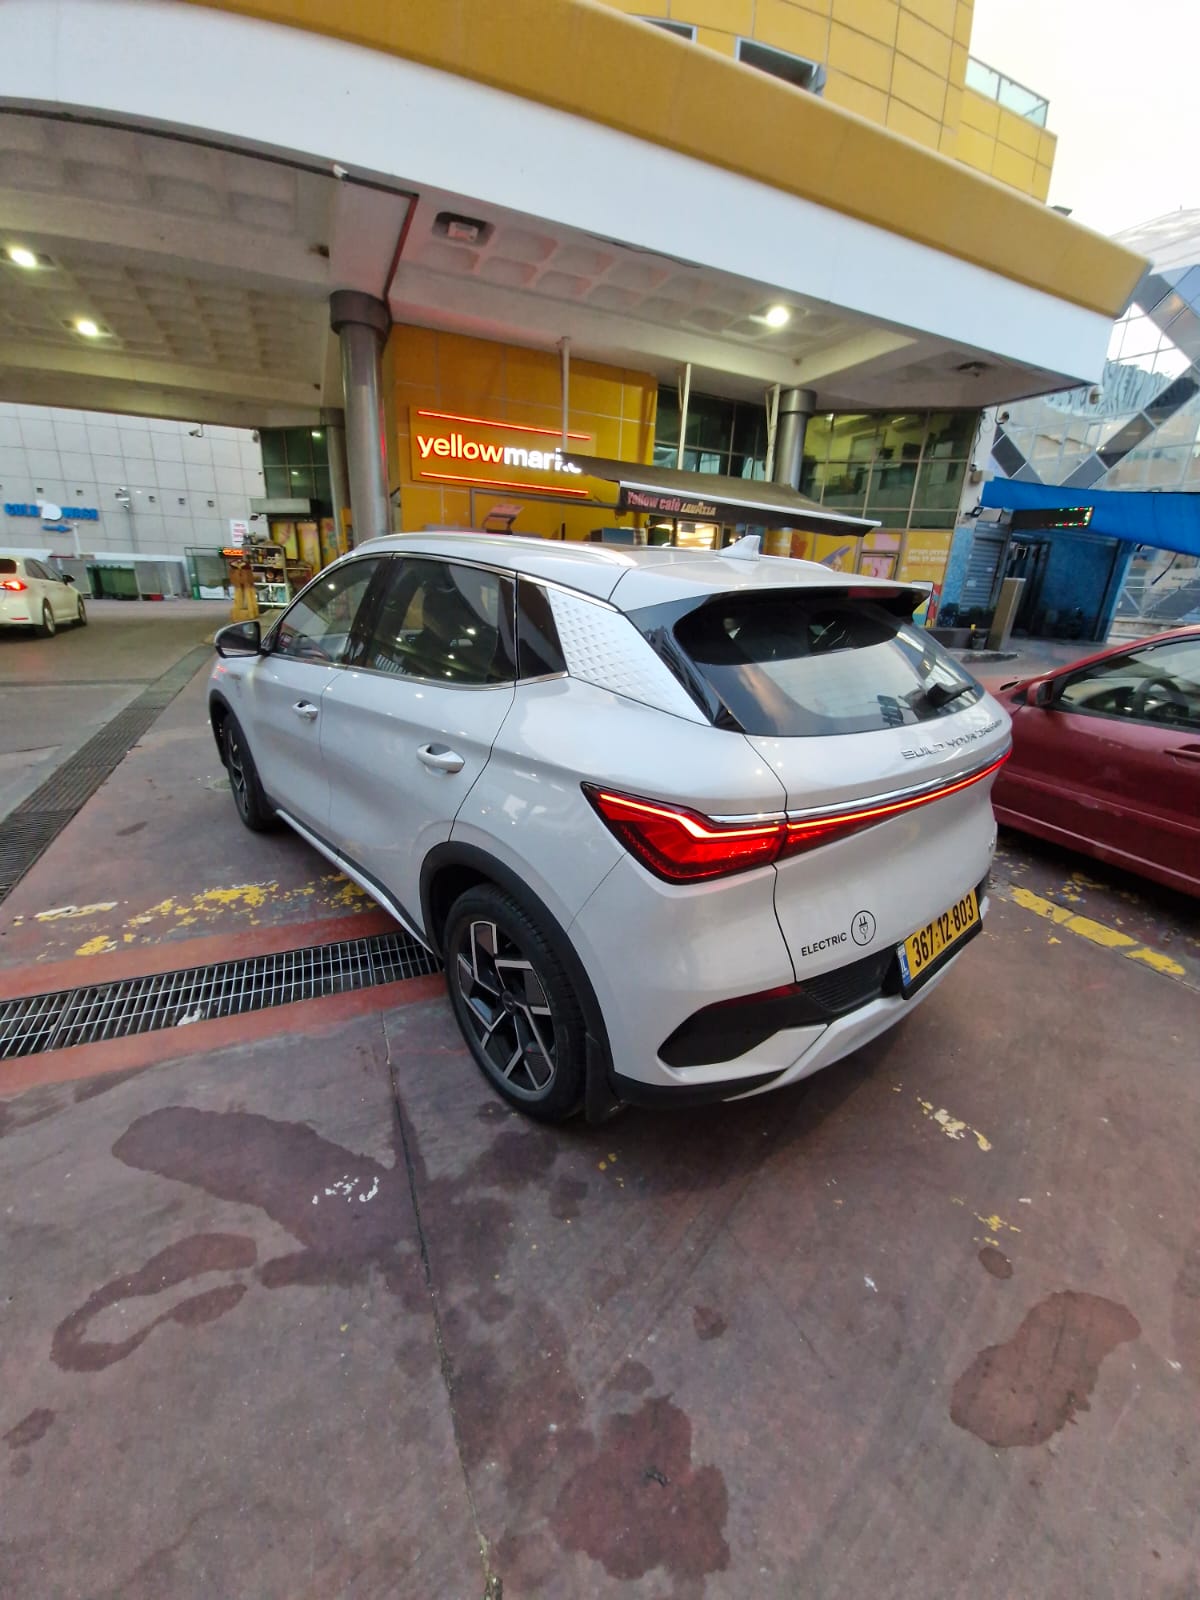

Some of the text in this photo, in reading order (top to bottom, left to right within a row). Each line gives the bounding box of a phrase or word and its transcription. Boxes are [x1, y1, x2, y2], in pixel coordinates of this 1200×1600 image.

[627, 491, 659, 508] Yellow
[901, 743, 944, 760] BUILD
[801, 932, 848, 957] ELECTRIC
